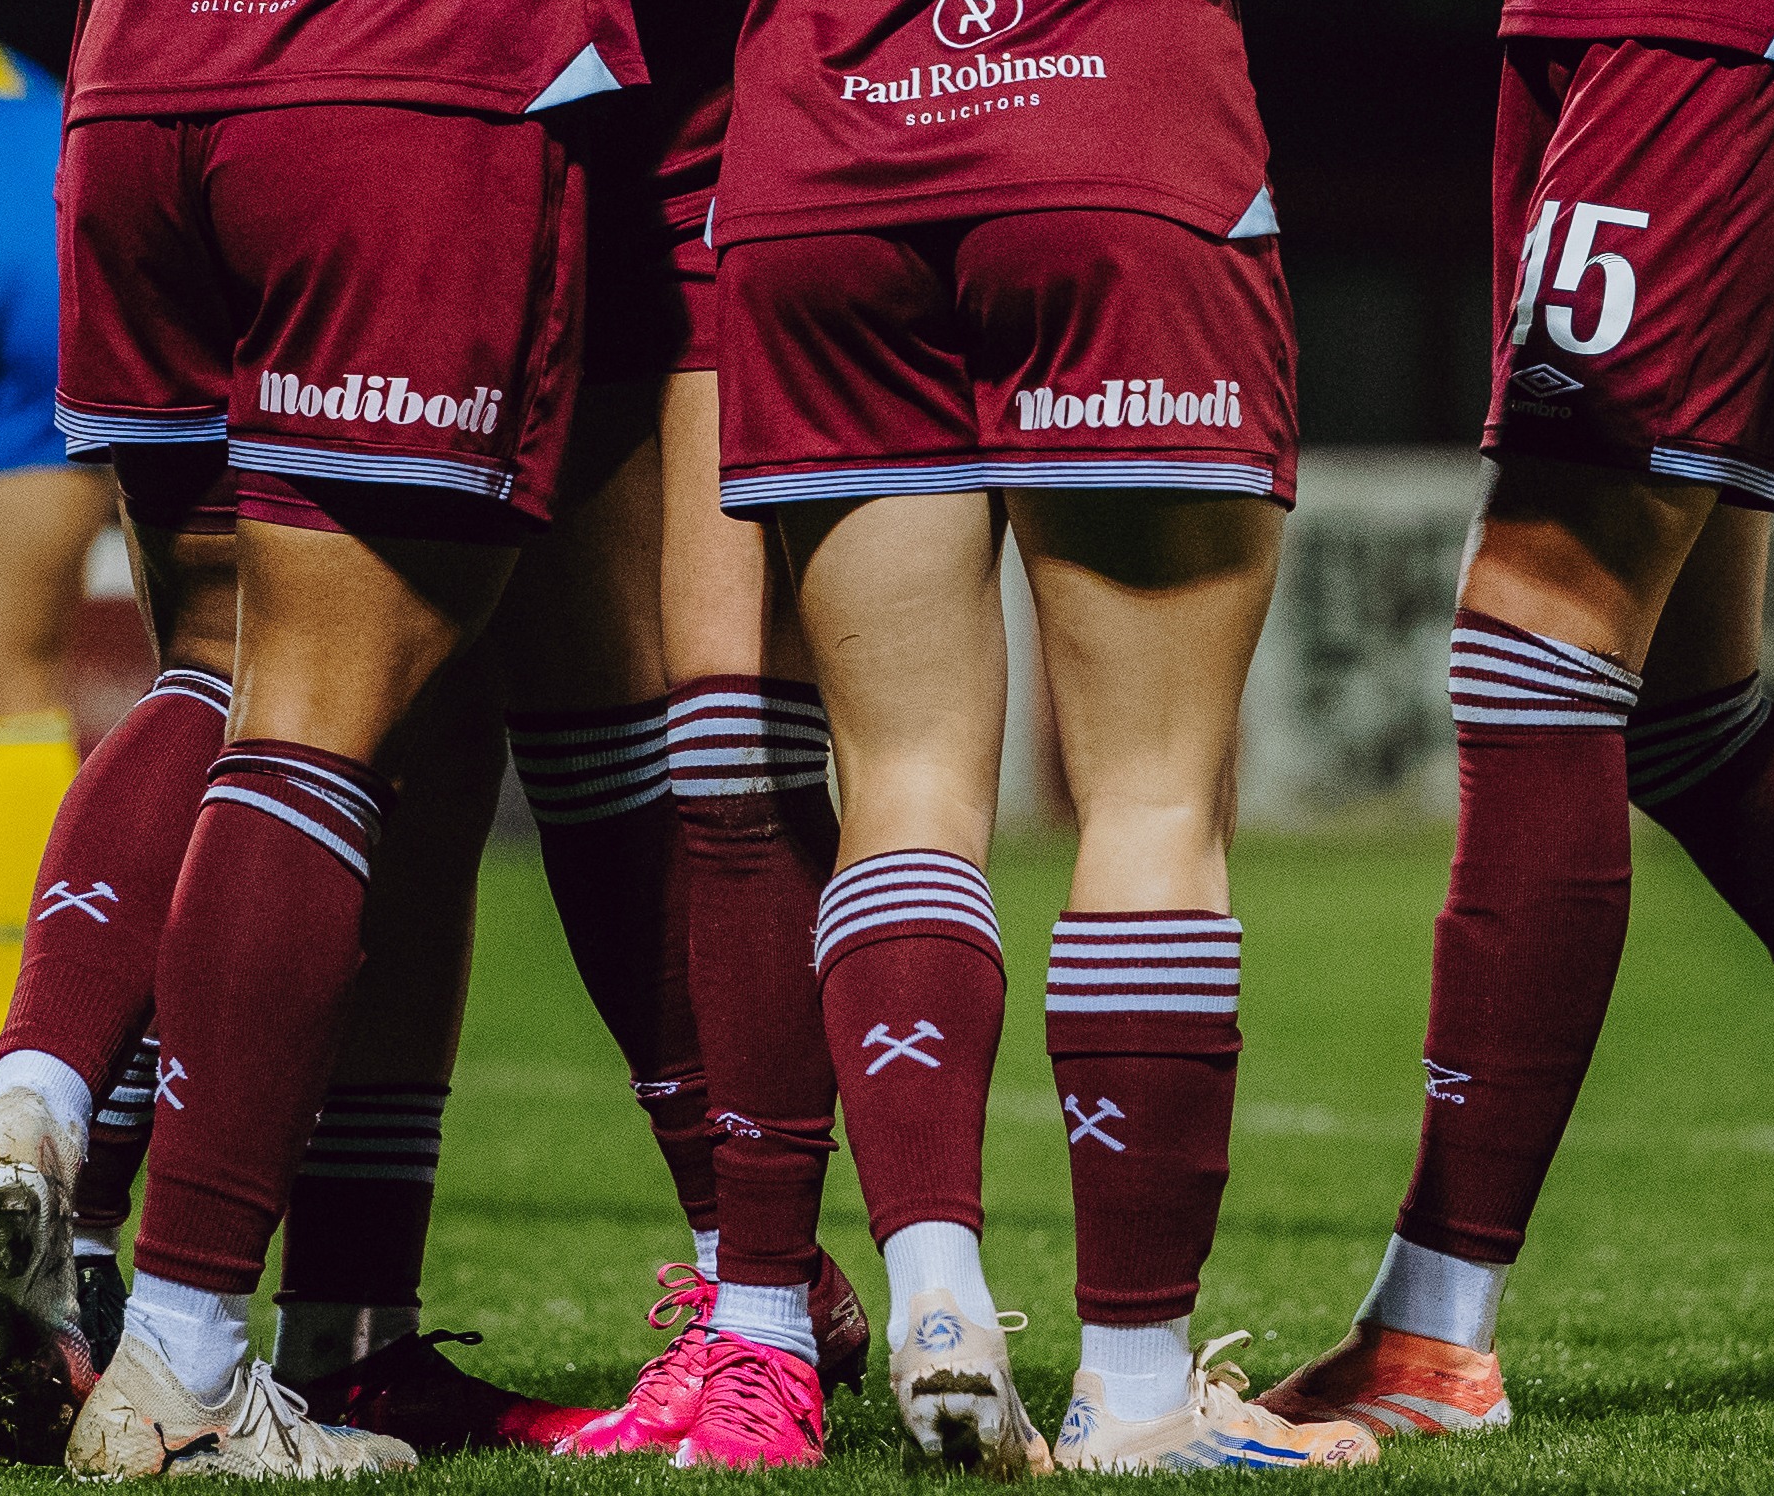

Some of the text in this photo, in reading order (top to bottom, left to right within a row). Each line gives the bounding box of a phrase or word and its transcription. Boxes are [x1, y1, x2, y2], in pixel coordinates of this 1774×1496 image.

[840, 53, 1107, 103] Paul Robinson
[905, 94, 1041, 126] SOLICITORS
[1512, 199, 1650, 355] 15
[260, 370, 503, 434] Modibodi
[1016, 378, 1243, 430] Modibodi
